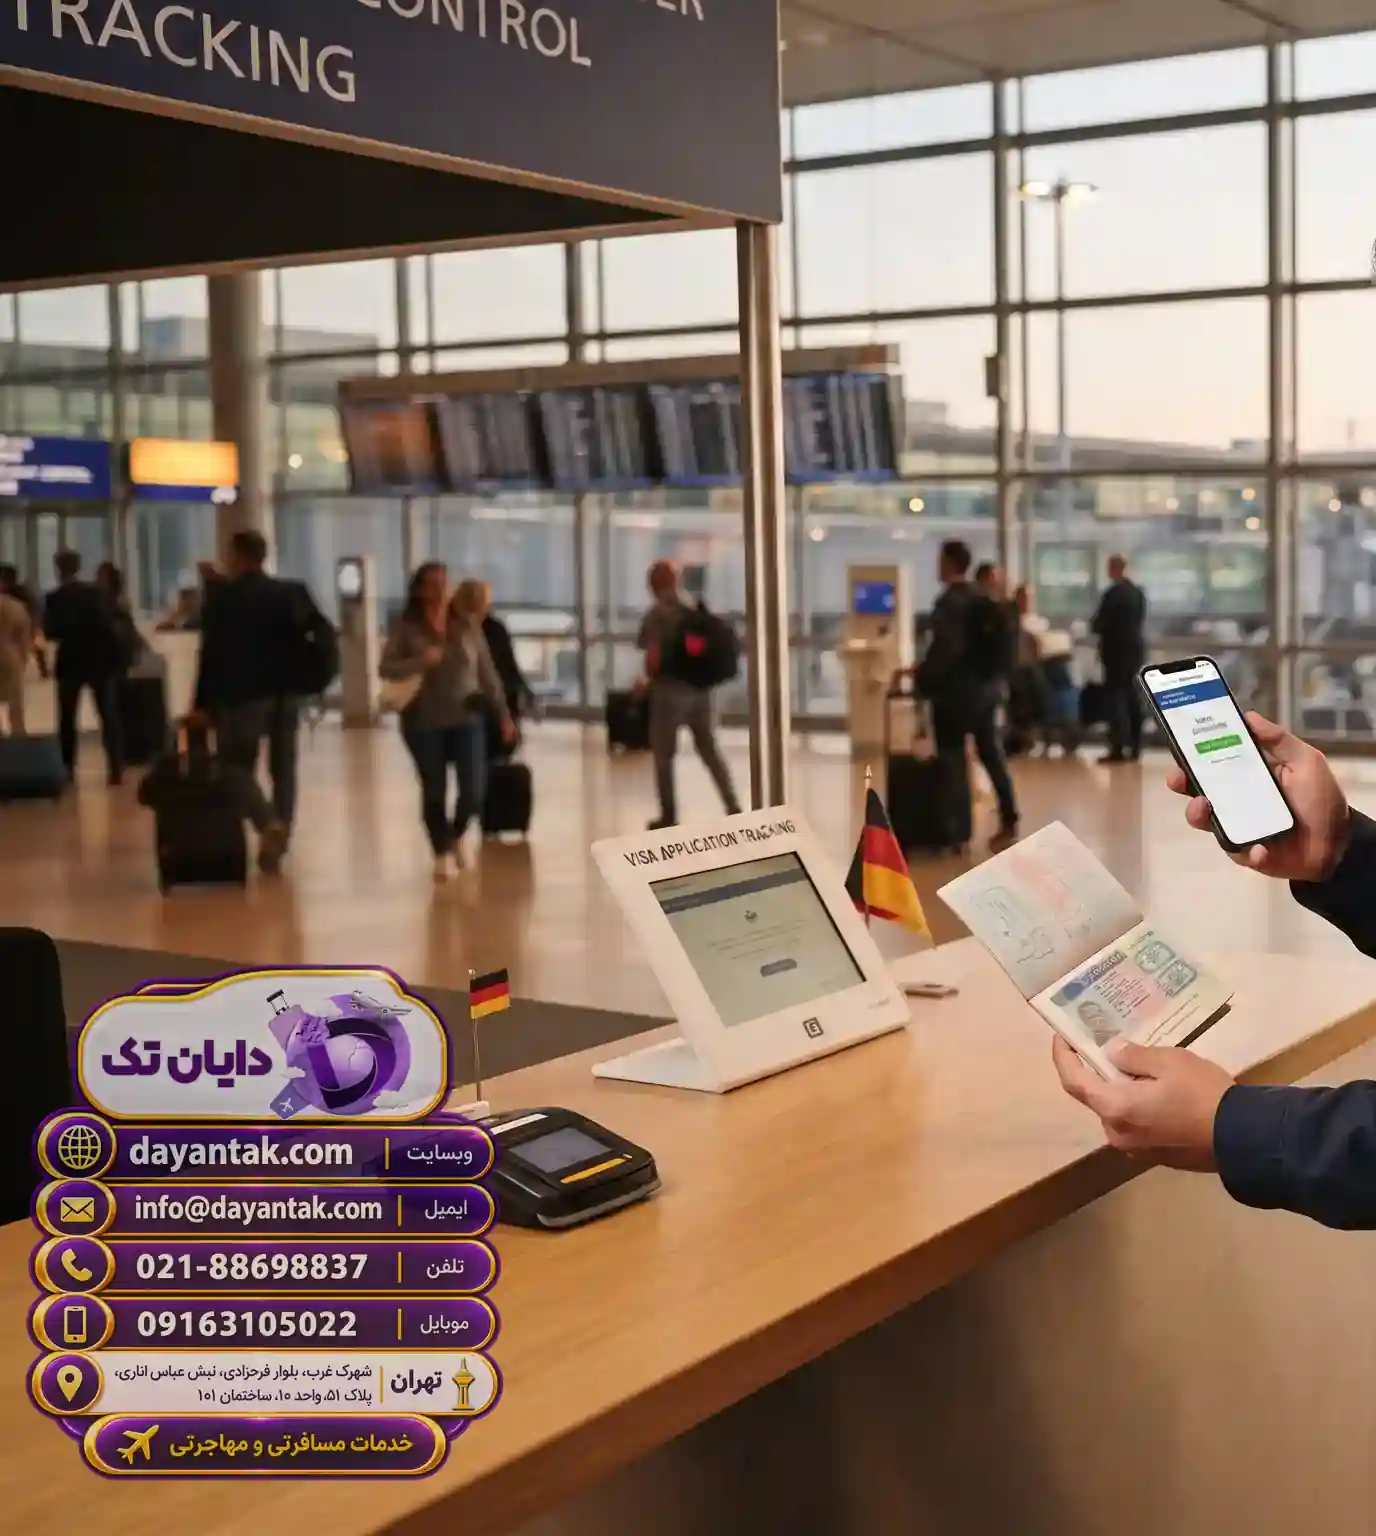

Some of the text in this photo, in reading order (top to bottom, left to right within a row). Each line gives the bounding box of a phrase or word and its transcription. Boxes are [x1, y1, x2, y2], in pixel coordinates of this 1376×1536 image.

[358, 0, 592, 67] NTROL
[623, 820, 796, 867] VISA APPLICATION TRACKING
